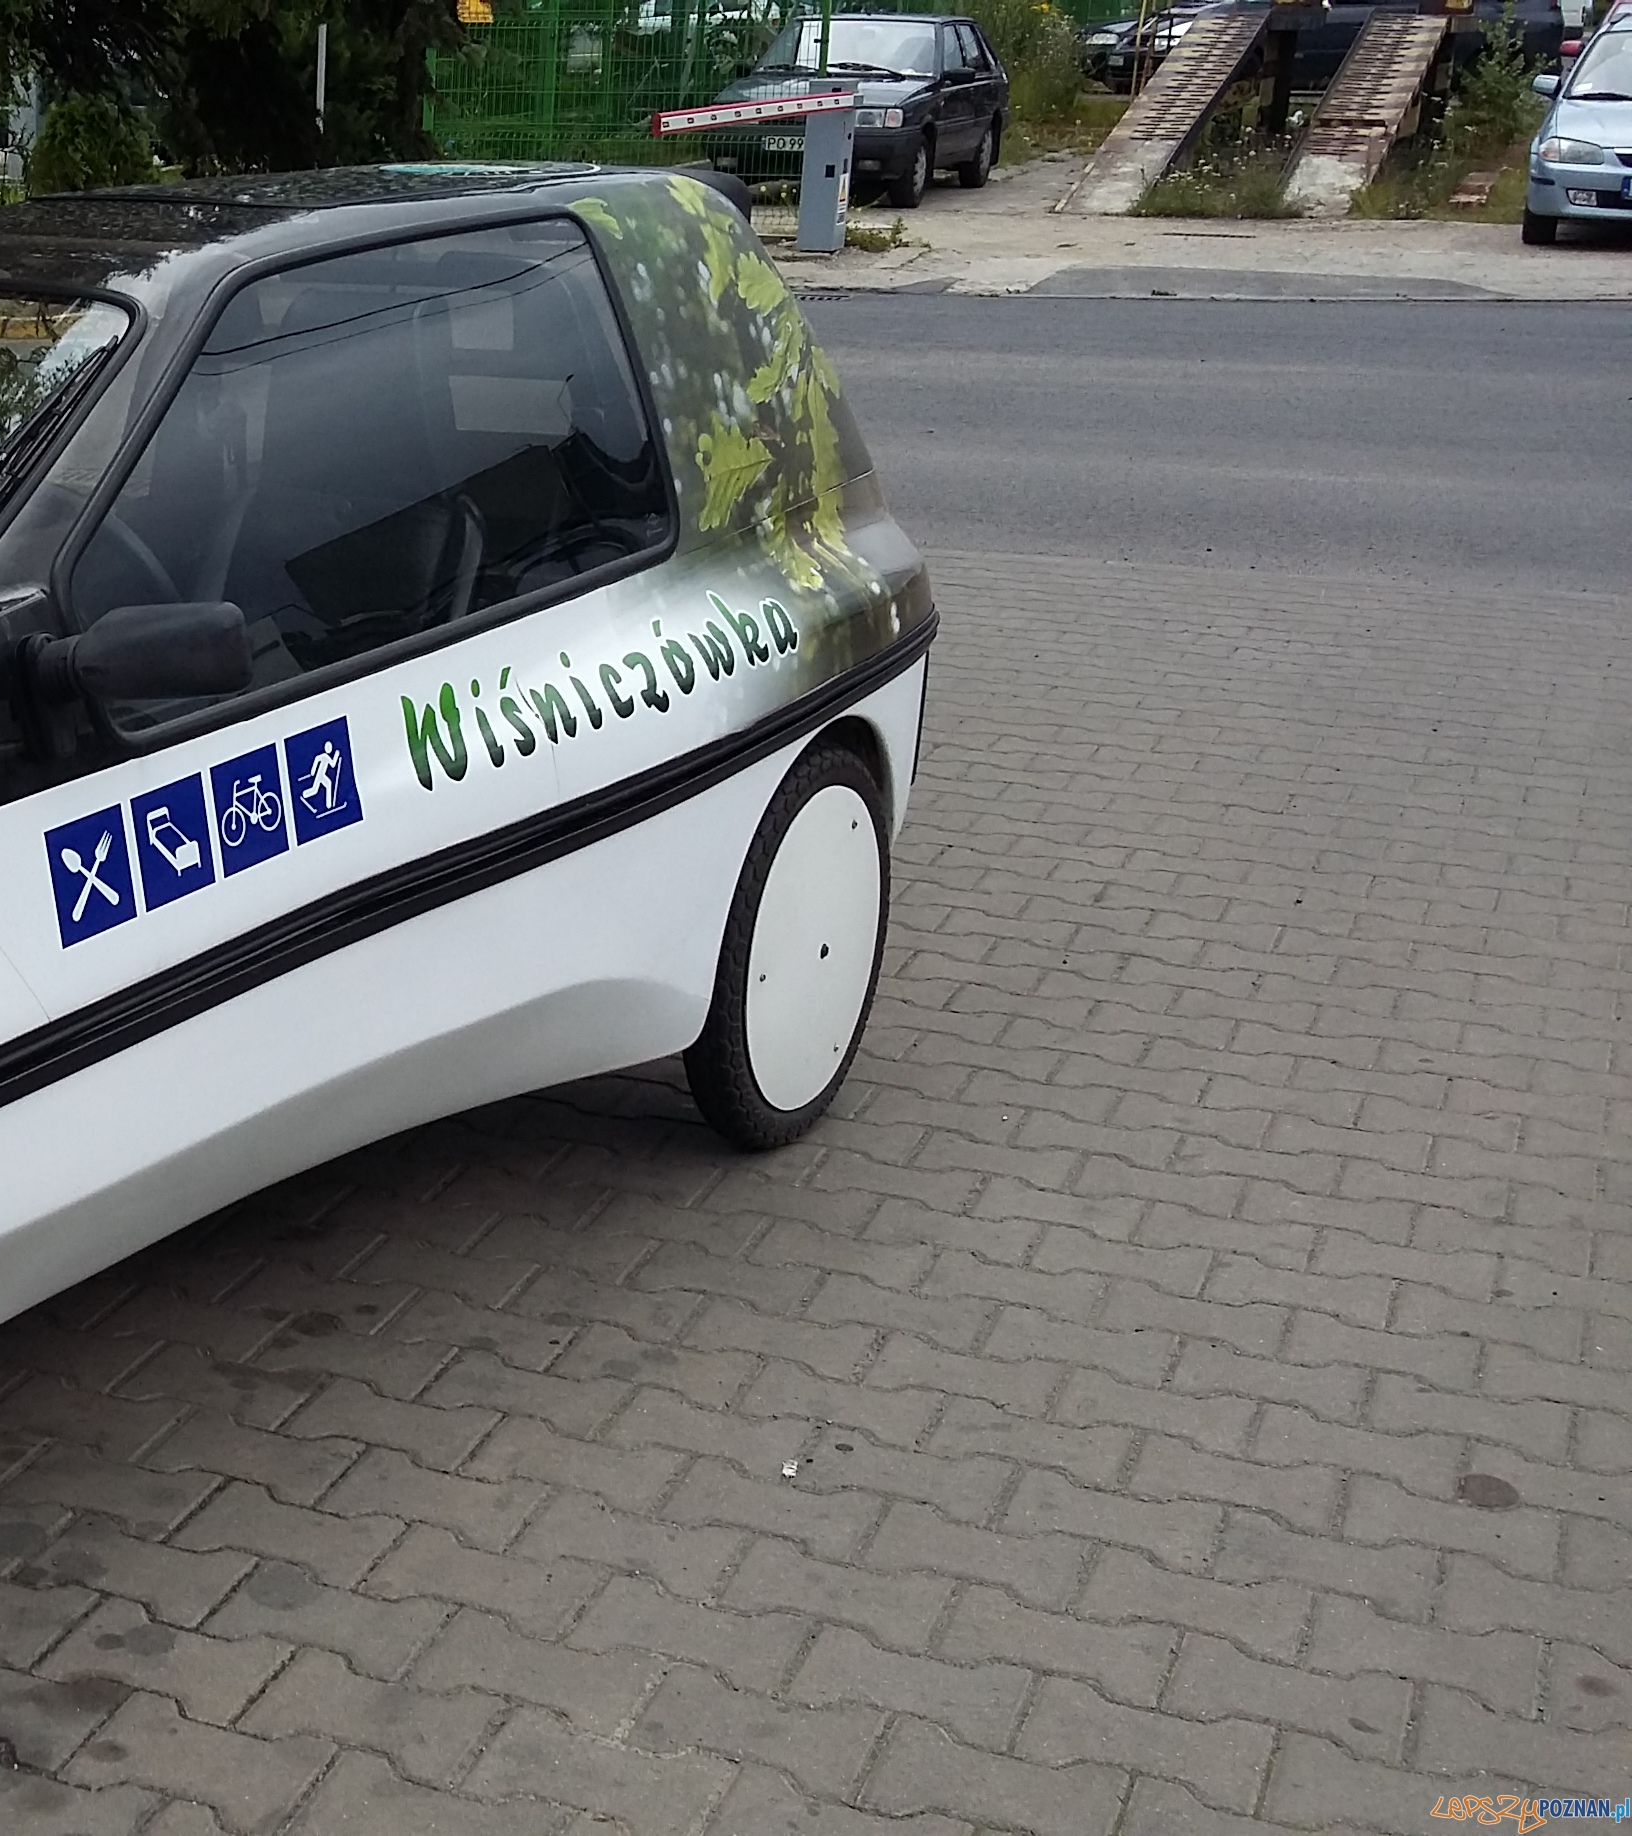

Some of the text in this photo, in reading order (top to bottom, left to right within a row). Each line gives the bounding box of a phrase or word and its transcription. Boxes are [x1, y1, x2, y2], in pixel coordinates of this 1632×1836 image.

[767, 136, 804, 150] PO 99
[400, 590, 799, 791] Wiśniczówka
